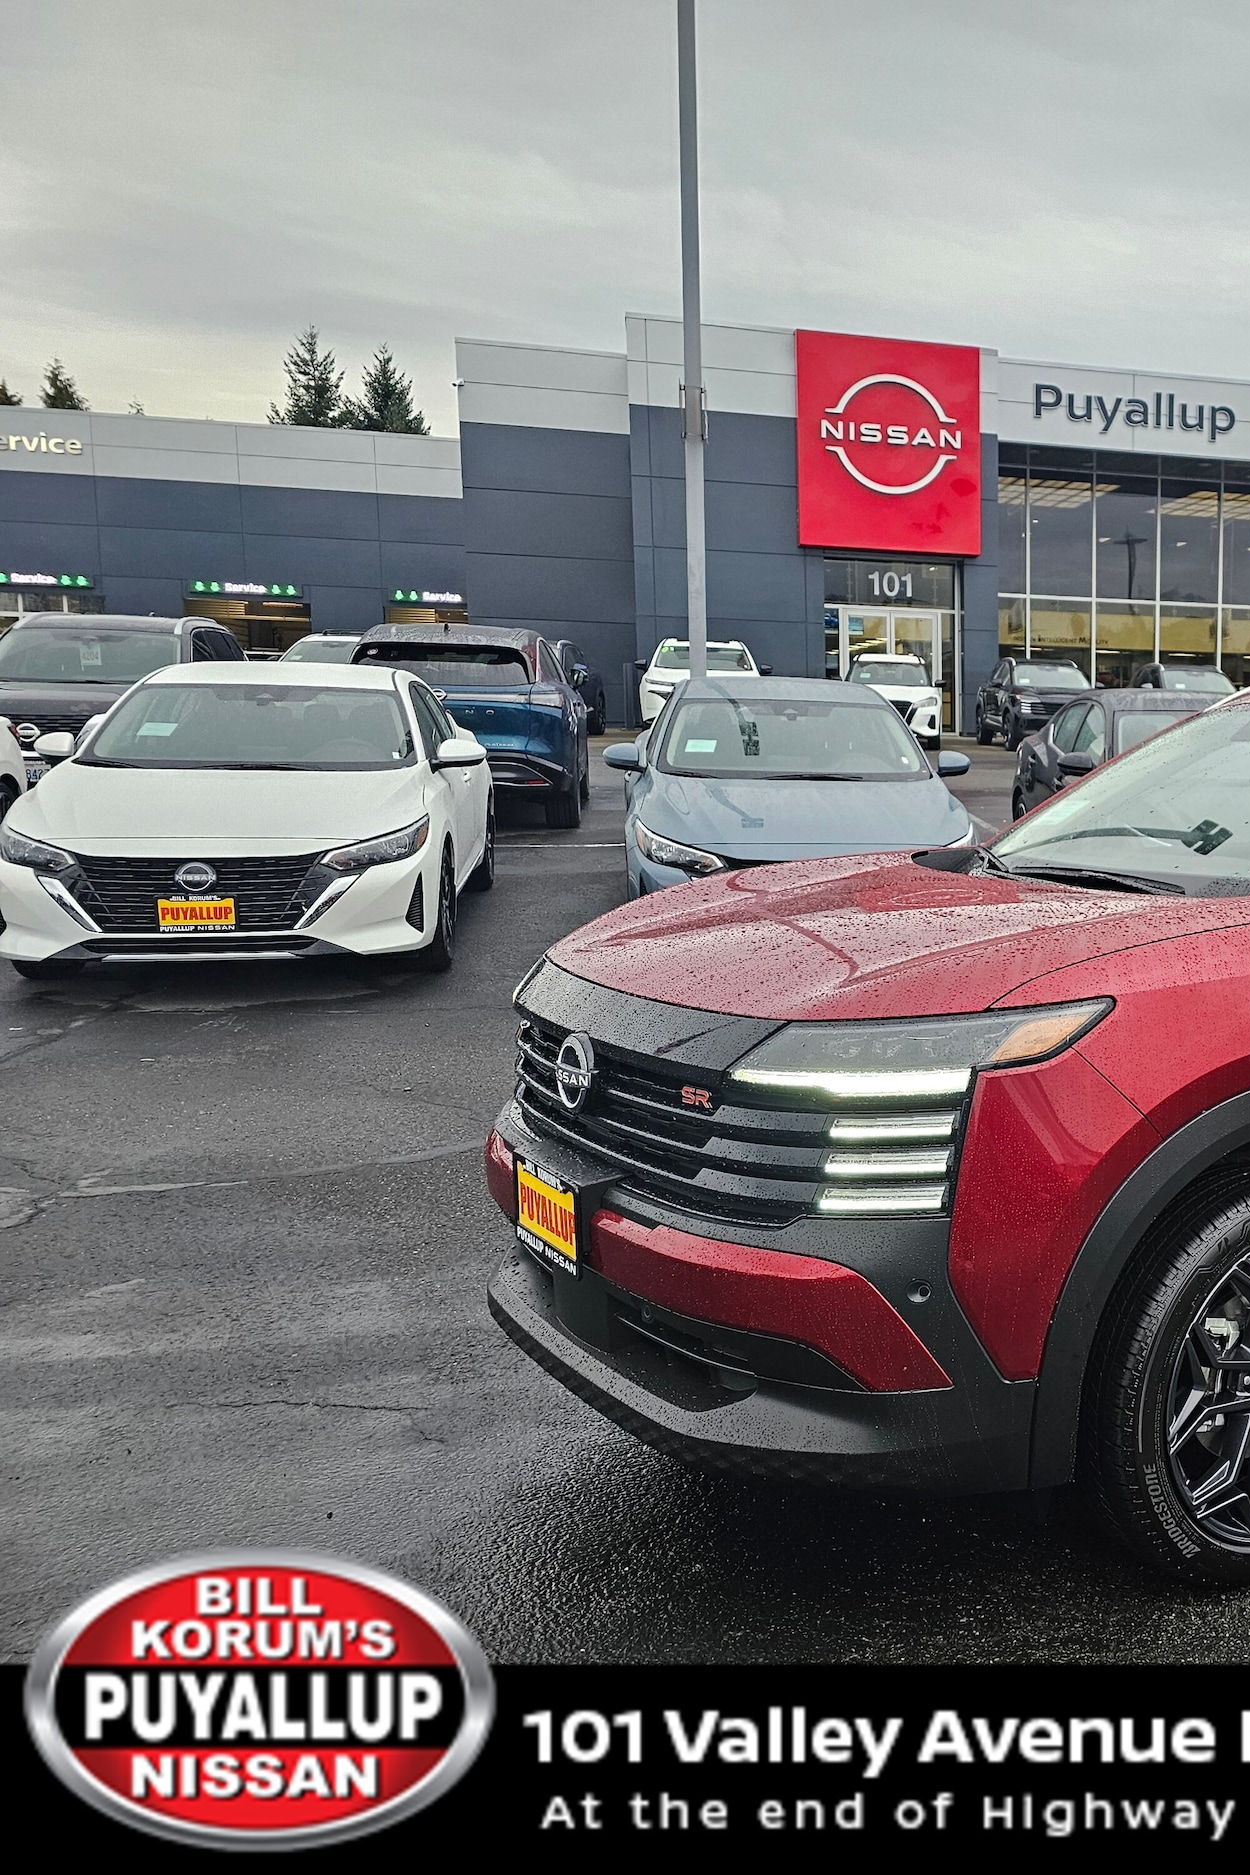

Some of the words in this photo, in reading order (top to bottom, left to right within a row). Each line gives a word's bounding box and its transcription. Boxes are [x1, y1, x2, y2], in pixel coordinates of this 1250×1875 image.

[1033, 383, 1236, 441] Puyallup
[820, 418, 961, 450] NISSAN
[224, 582, 267, 594] Service
[422, 591, 462, 602] Service
[868, 570, 912, 598] 101
[175, 873, 216, 881] NISSAN
[160, 906, 233, 921] PUYALLUP
[681, 1086, 711, 1109] SR
[520, 1181, 576, 1246] PUYALLUP
[517, 1226, 545, 1253] PUYALLUP
[544, 1246, 577, 1276] NISSAN
[1143, 1463, 1201, 1559] BRIDGESTONE
